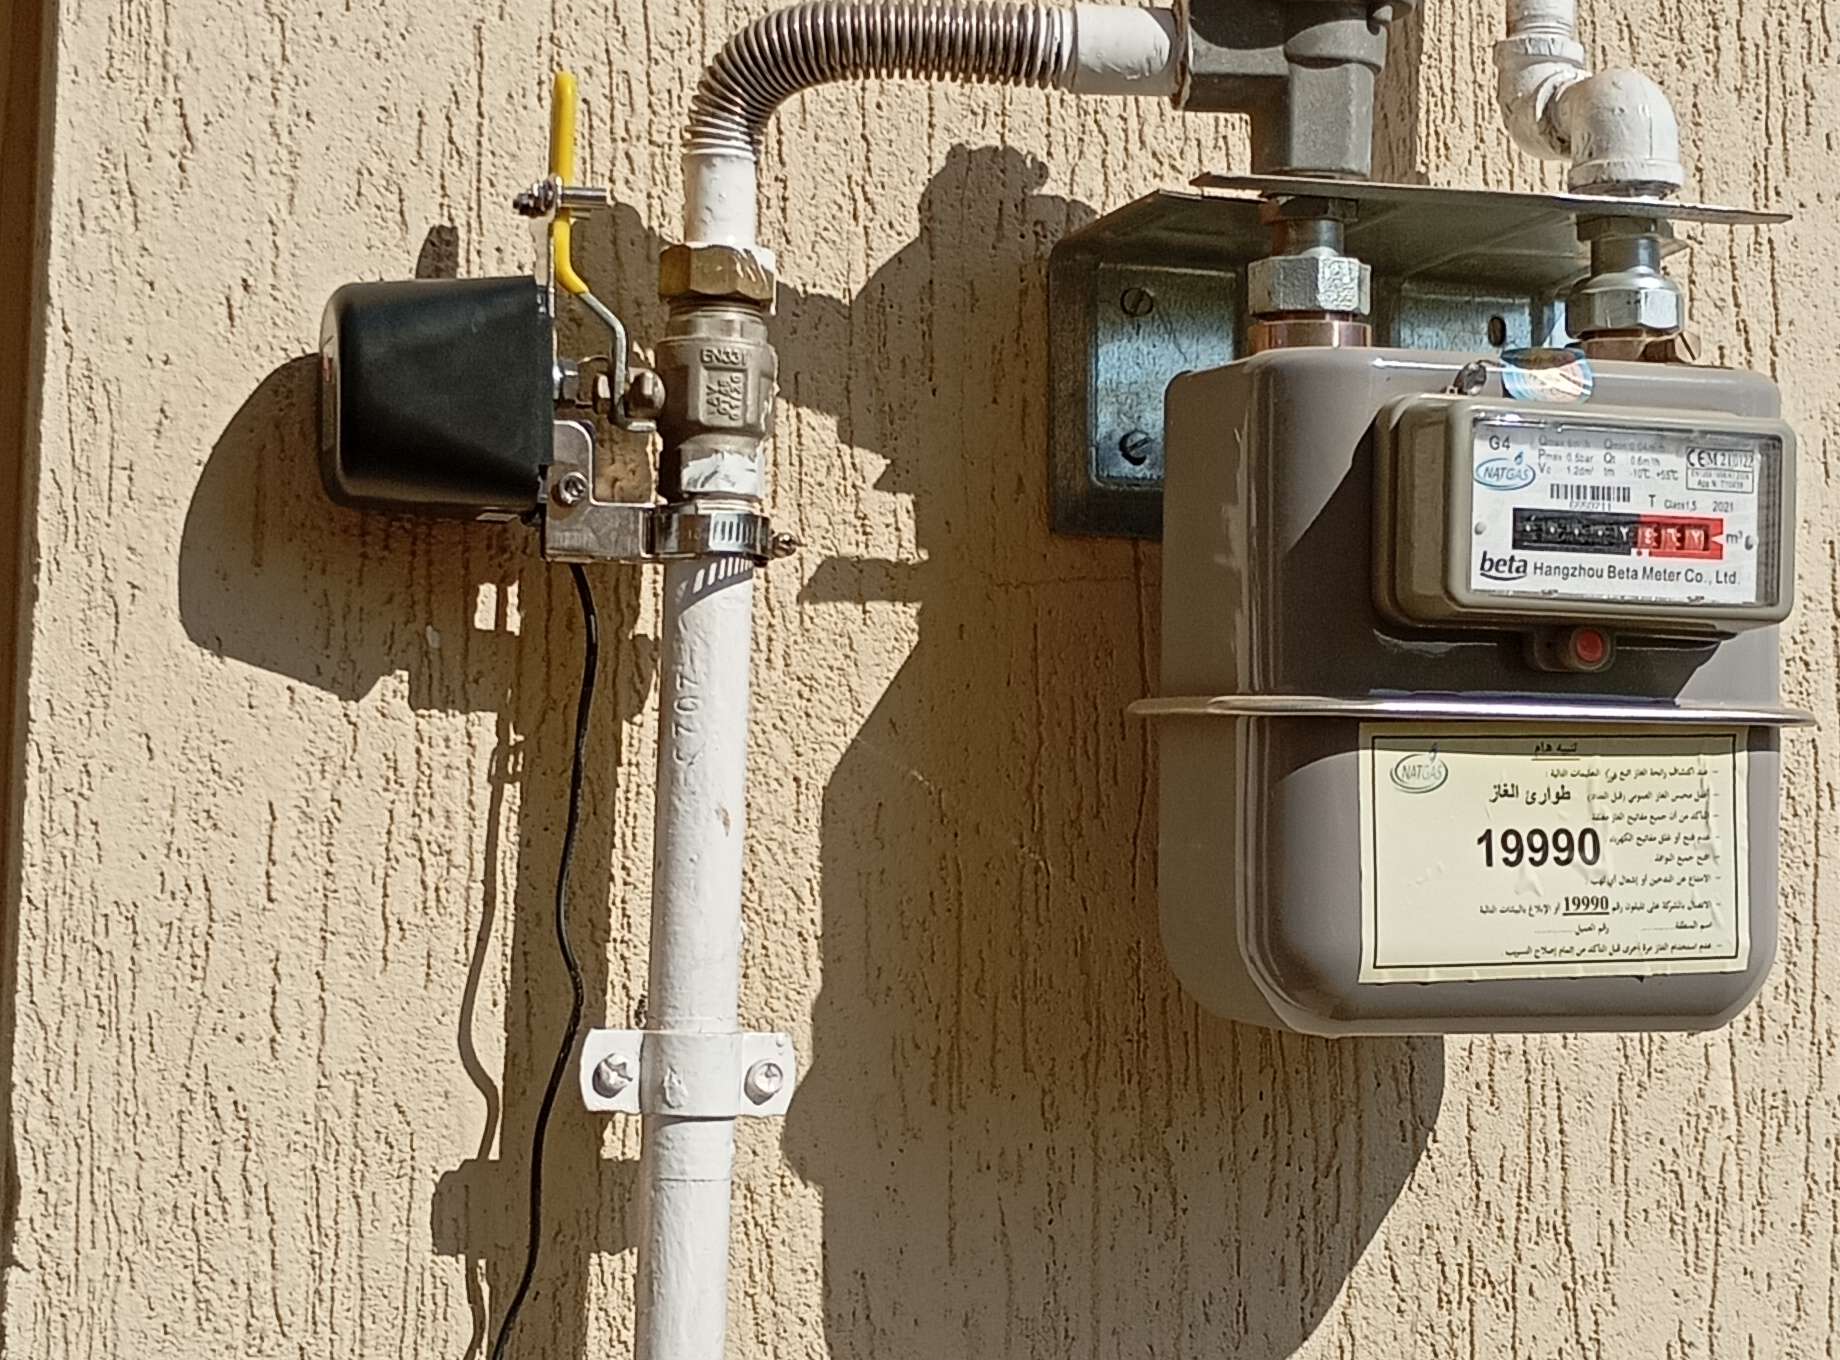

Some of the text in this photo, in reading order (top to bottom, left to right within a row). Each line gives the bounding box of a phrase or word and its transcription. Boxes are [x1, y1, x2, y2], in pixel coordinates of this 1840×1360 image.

[1488, 435, 1511, 451] G4
[1483, 466, 1530, 482] NATGAS
[1712, 500, 1734, 514] 2021
[1479, 550, 1528, 574] beta
[1533, 562, 1604, 581] Hangzhou
[1607, 564, 1638, 580] Beta
[1641, 566, 1682, 582] Meter
[1401, 763, 1443, 780] NATGAS
[1489, 783, 1571, 806] طوارئ الغاز
[1477, 827, 1601, 868] 19990
[1564, 895, 1609, 912] 19990
